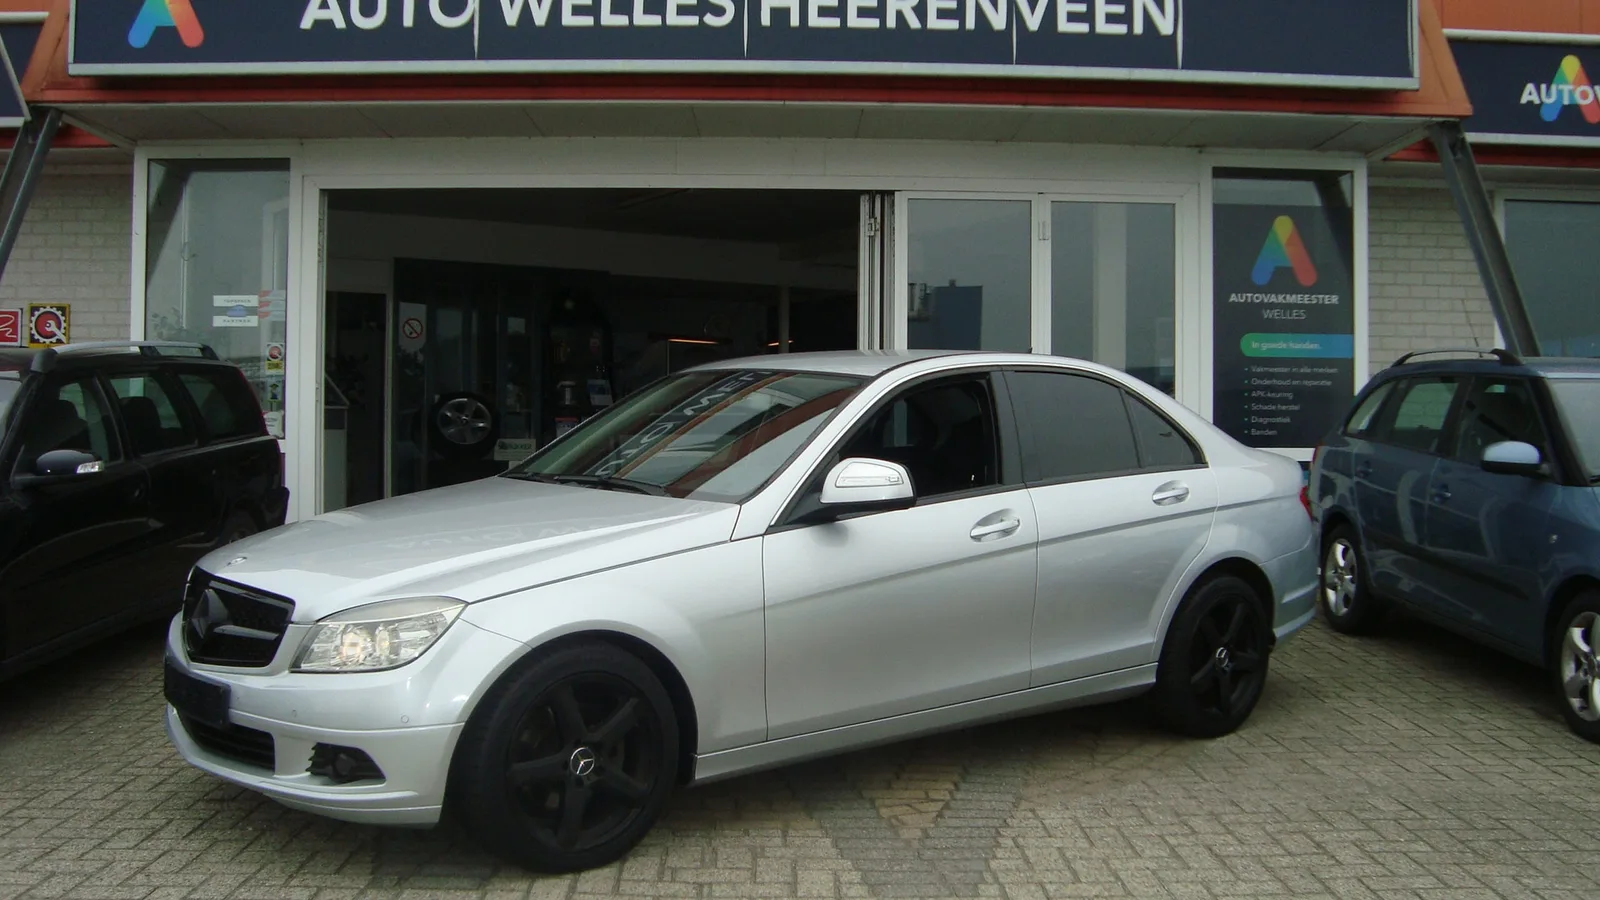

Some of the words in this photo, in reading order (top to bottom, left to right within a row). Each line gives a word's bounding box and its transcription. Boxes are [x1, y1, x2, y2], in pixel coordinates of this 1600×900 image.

[1228, 292, 1340, 305] AUTOVAKMEESTER
[1261, 308, 1307, 320] WELLES
[1251, 341, 1260, 349] In
[1260, 341, 1288, 351] goede
